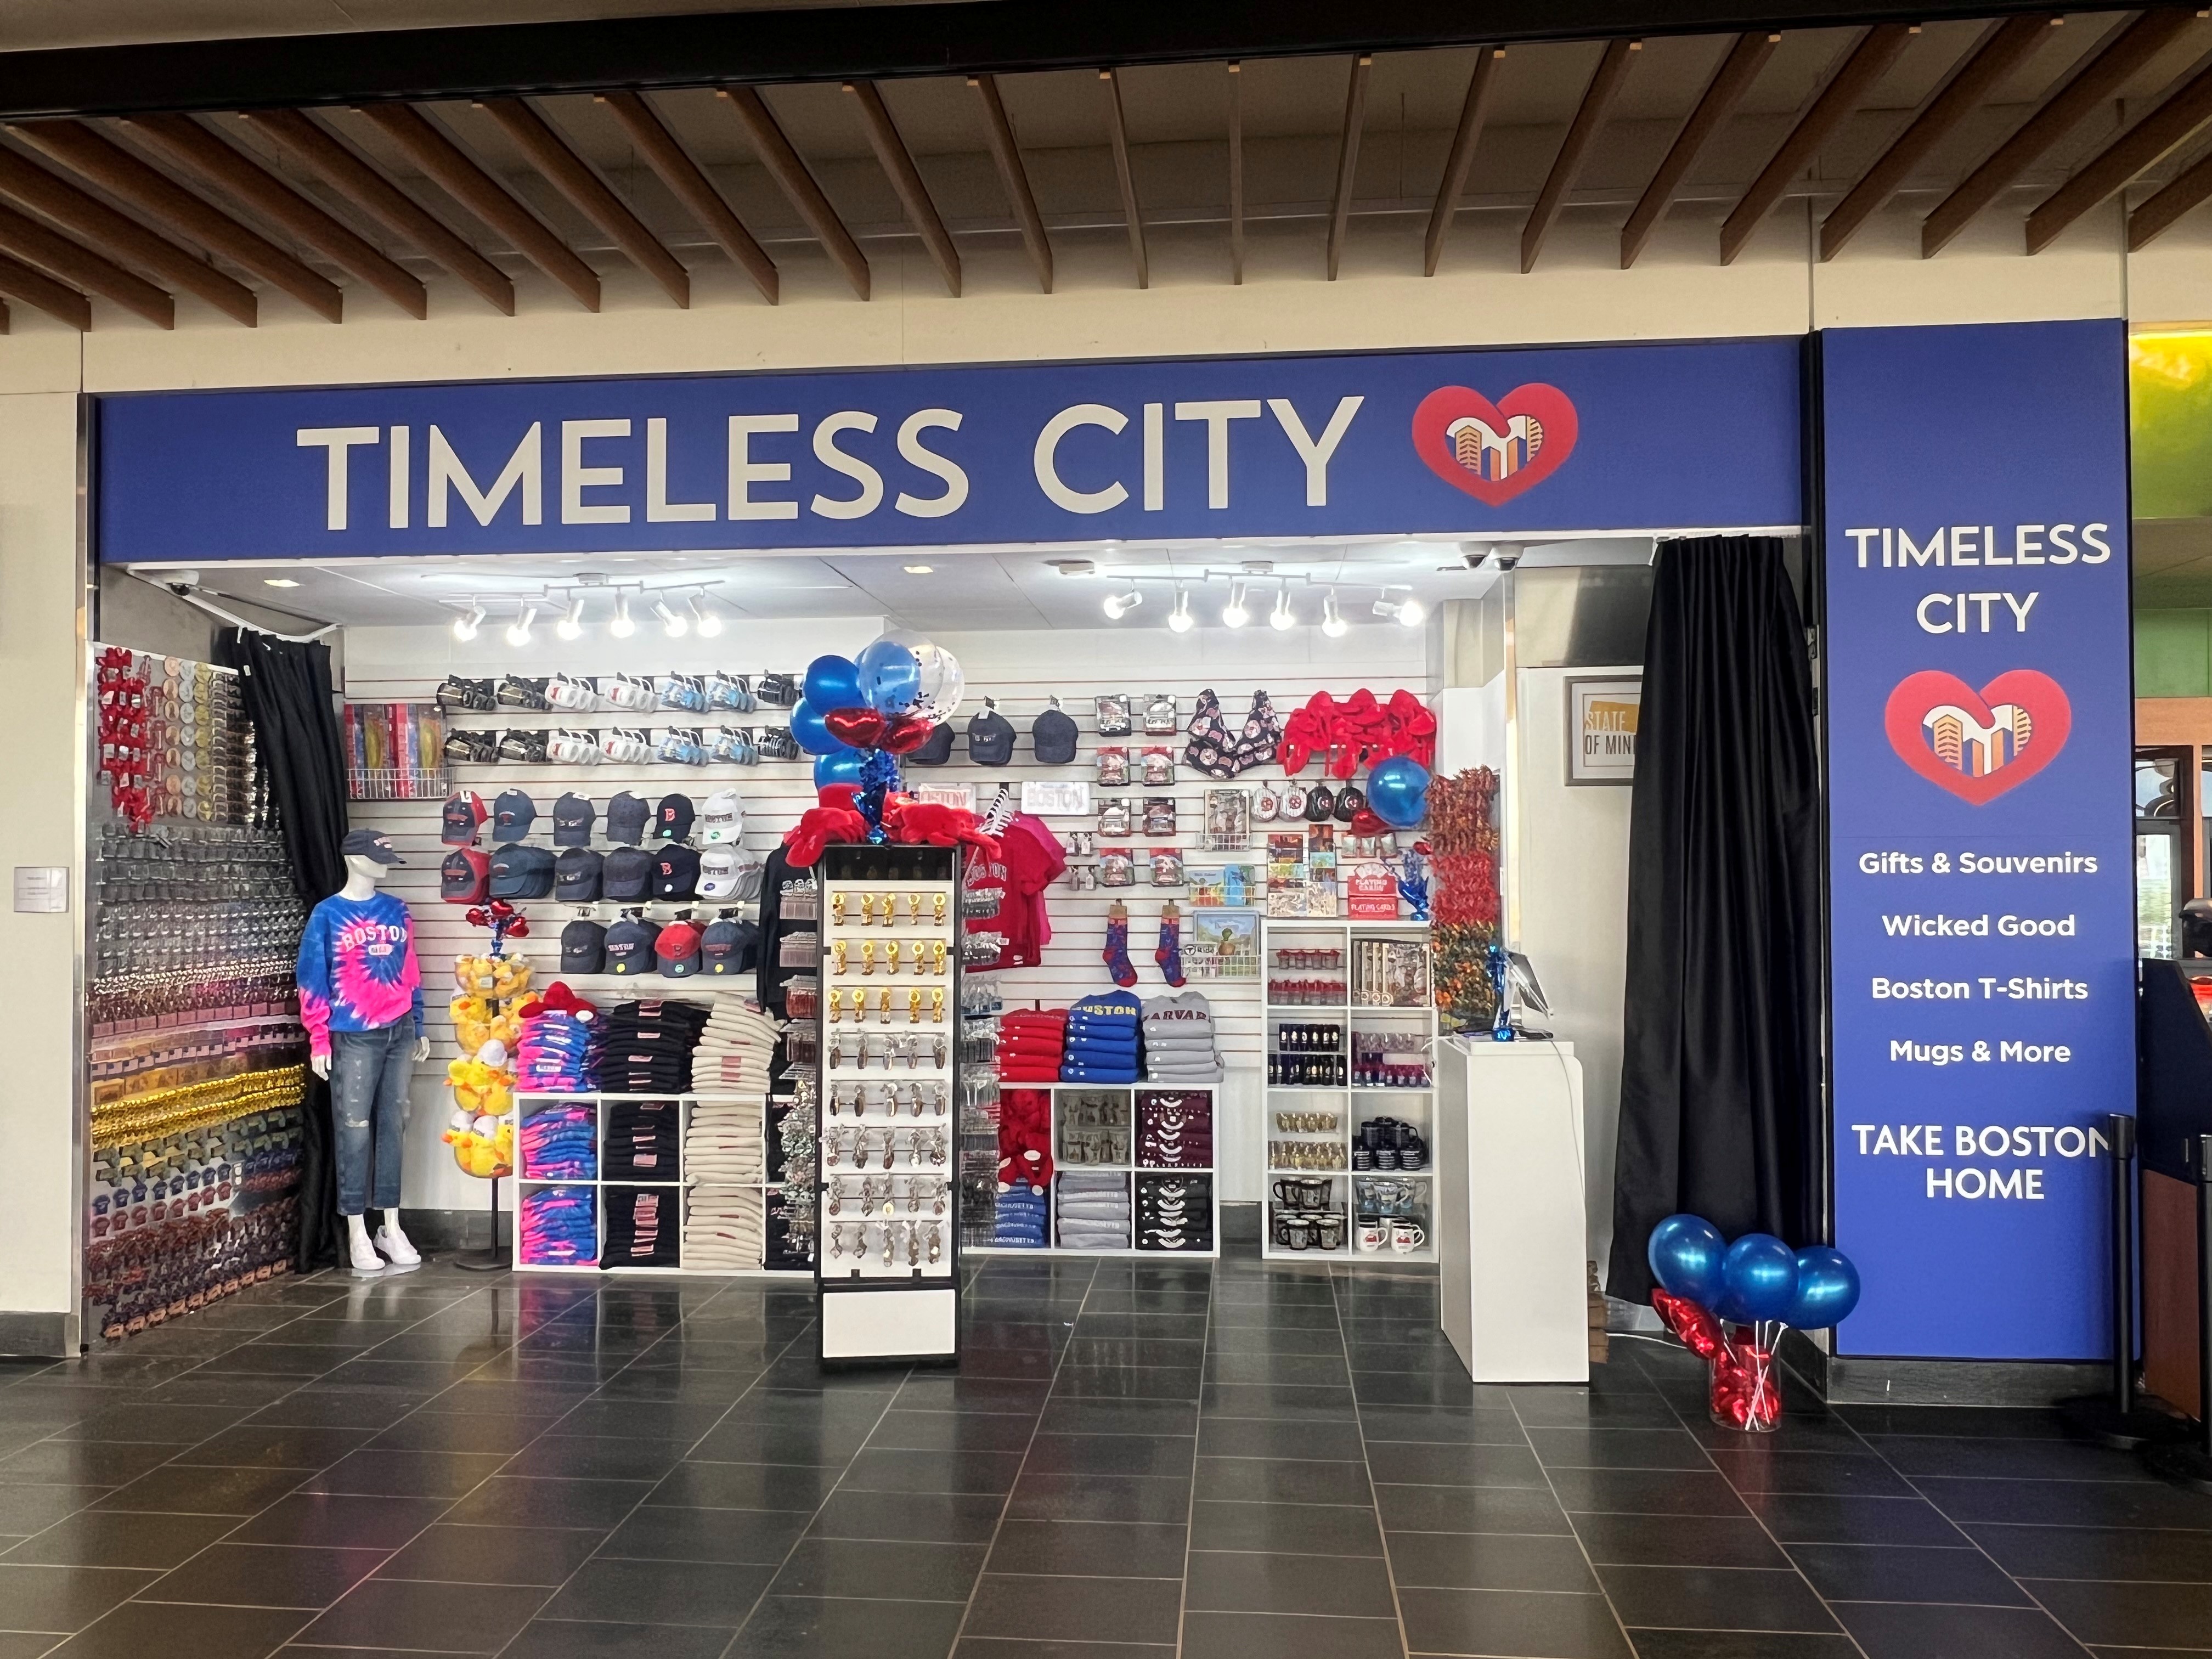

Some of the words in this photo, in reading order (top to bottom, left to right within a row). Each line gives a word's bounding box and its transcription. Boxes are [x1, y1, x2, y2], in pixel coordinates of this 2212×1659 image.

[296, 408, 969, 531] TIMELESS
[1033, 395, 1365, 514] CITY
[1844, 522, 2111, 569] TIMELESS
[1916, 591, 2040, 635] CITY
[1584, 735, 1600, 755] OF
[1605, 735, 1635, 755] MIN
[1858, 851, 1924, 874] Gifts
[1931, 852, 1951, 874] &
[1959, 851, 2098, 874] Souvenirs
[1881, 913, 1989, 937] Wicked
[1997, 913, 2076, 937] Good
[1872, 977, 1970, 1000] Boston
[1977, 977, 2089, 1000] T-Shirts
[1072, 1005, 1137, 1017] OSTON
[1890, 1040, 1963, 1066] Mugs
[1971, 1040, 1991, 1063] &
[2000, 1040, 2072, 1063] More
[1851, 1124, 1944, 1156] TAKE
[1955, 1125, 2110, 1158] BOSTON
[1926, 1167, 2045, 1200] HOME
